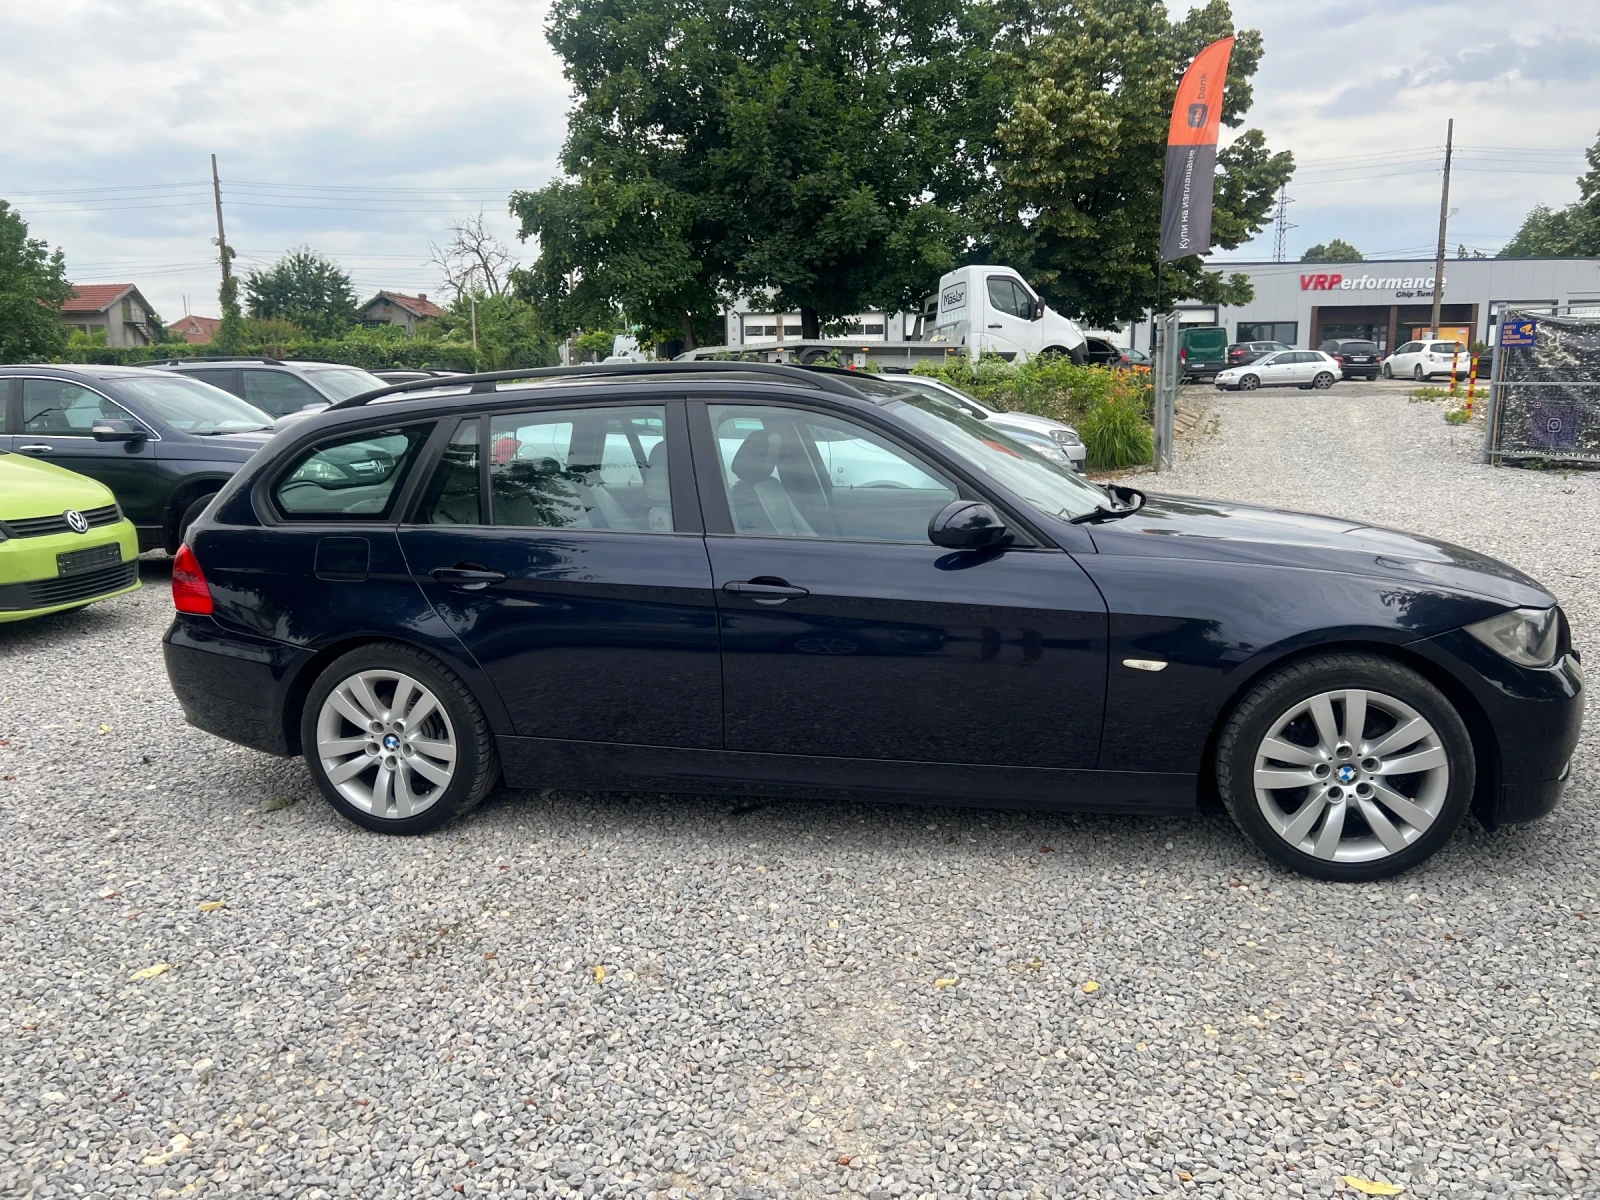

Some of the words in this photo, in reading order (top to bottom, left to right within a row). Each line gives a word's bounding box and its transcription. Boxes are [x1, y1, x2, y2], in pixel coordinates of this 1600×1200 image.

[1197, 72, 1207, 100] bank
[1182, 149, 1195, 209] изплащане
[1181, 209, 1189, 223] на
[1179, 224, 1190, 249] Купи
[943, 289, 965, 307] Master
[1395, 290, 1414, 299] Chip
